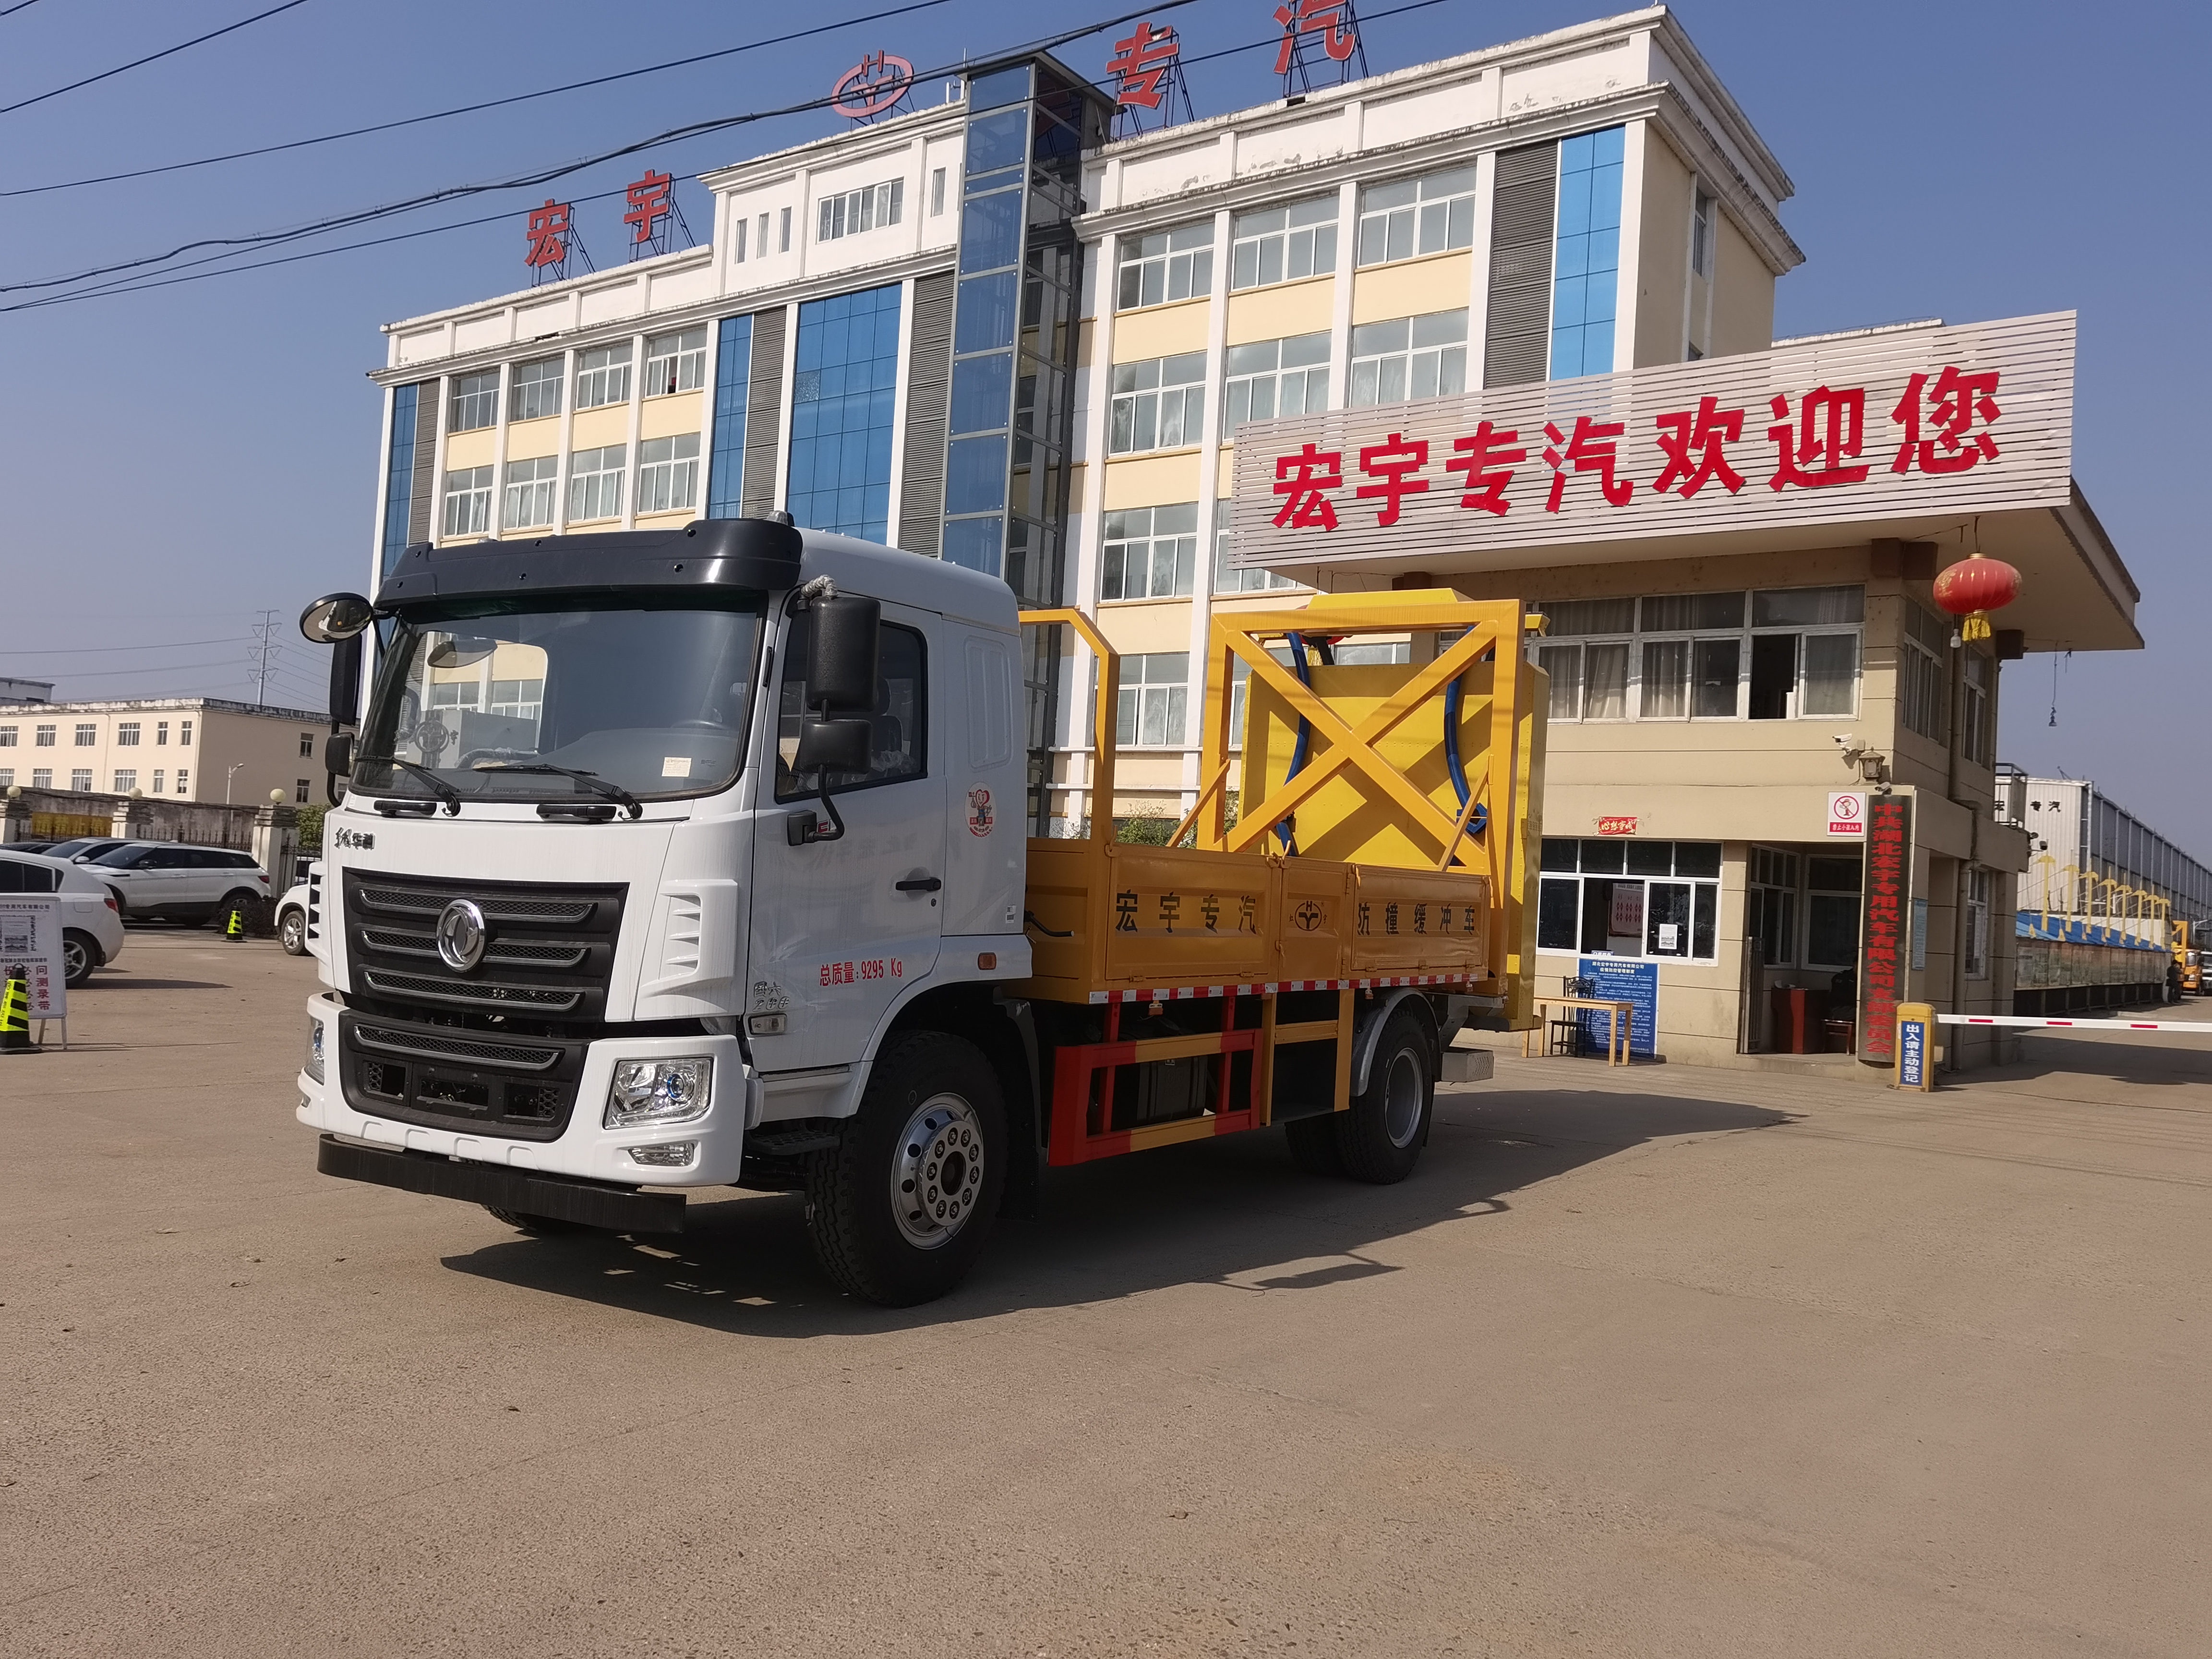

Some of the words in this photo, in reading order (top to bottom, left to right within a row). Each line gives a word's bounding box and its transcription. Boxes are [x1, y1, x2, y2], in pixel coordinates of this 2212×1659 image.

[1270, 365, 2002, 533] 宏宇专汽欢迎您
[1115, 889, 1257, 934] 宏宇专汽
[1357, 902, 1475, 936] 防撞缓冲车
[890, 957, 902, 978] Kg
[1904, 1024, 1920, 1083] 出入请主动登记
